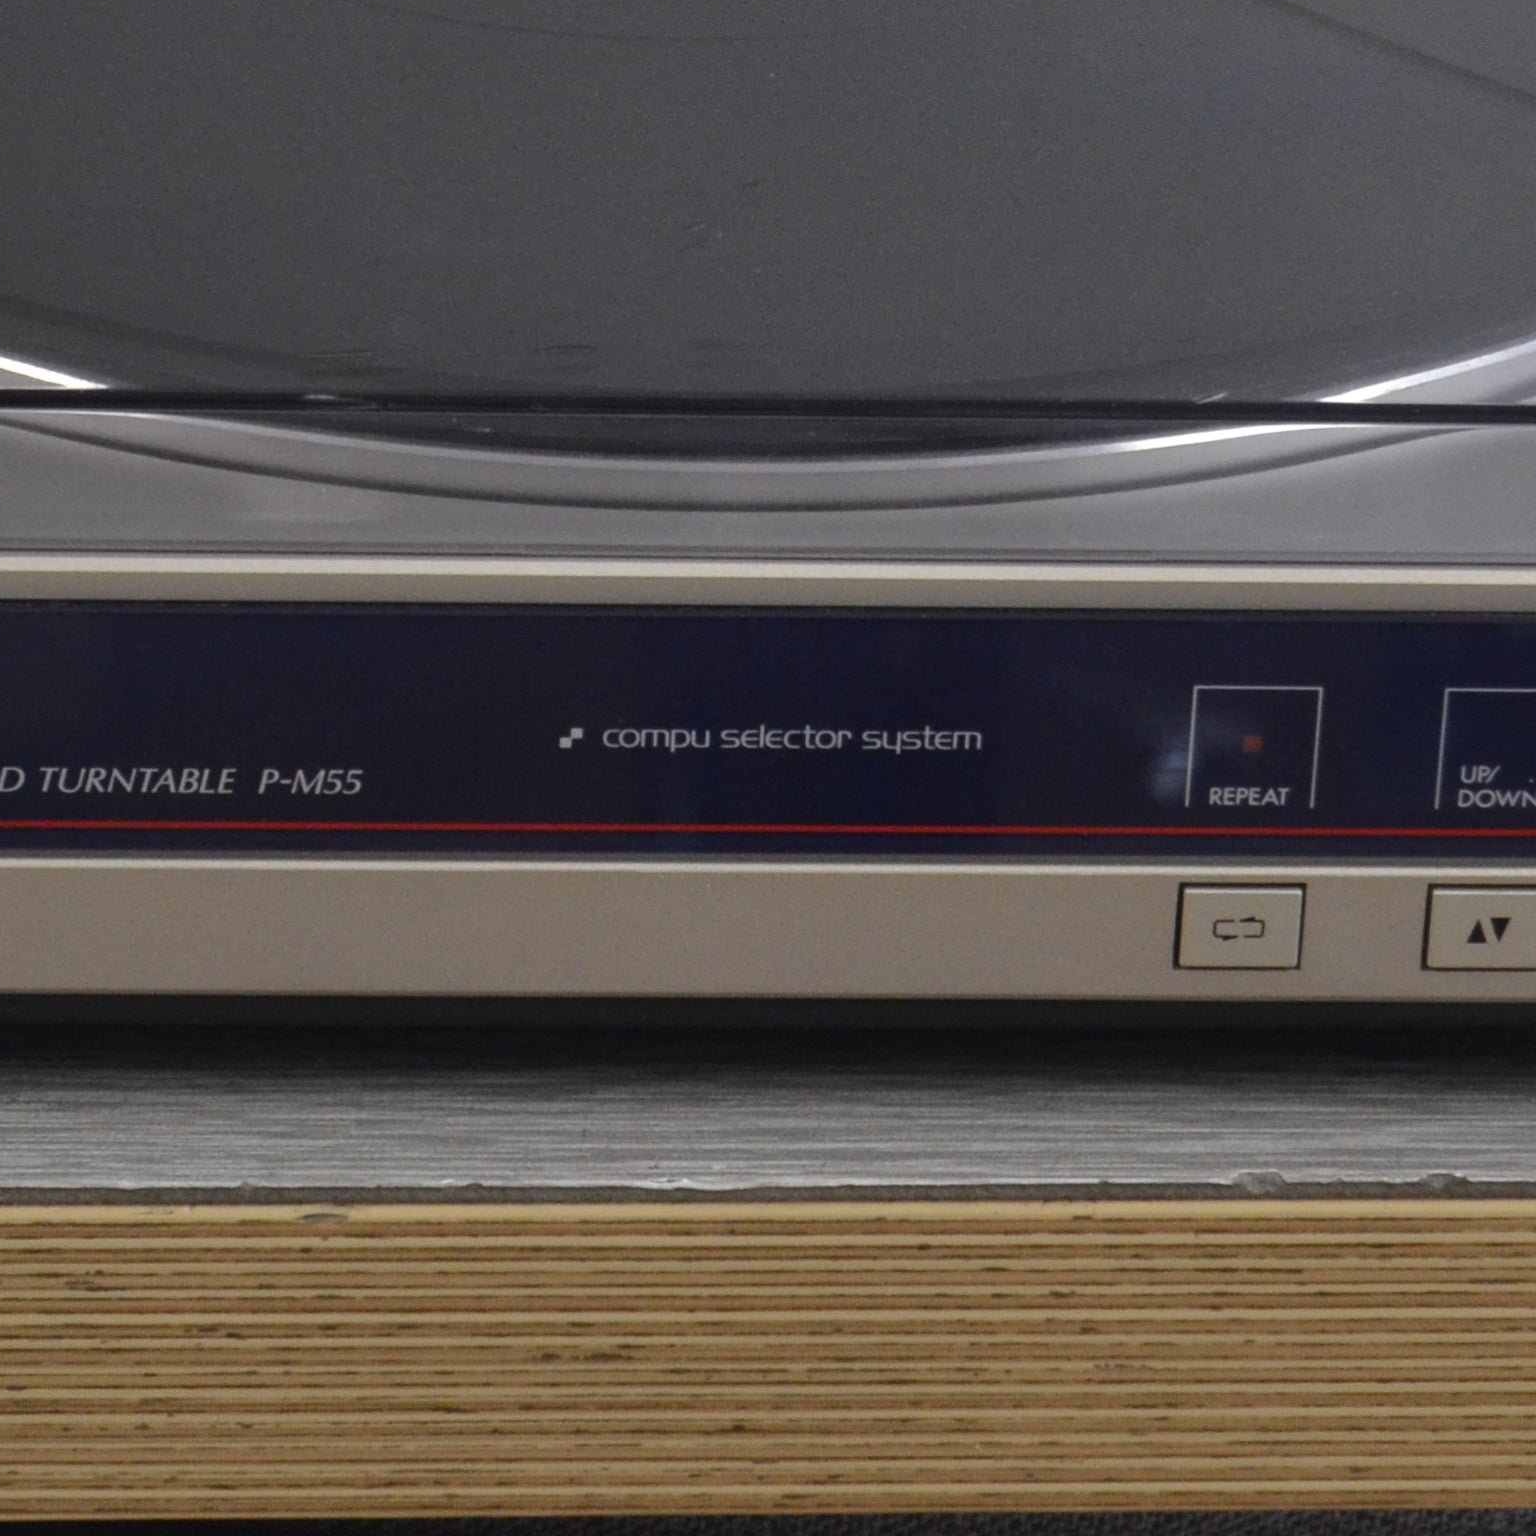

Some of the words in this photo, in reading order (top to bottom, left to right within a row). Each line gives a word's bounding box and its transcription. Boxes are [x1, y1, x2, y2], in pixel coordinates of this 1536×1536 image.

[602, 727, 710, 753] compu
[720, 725, 853, 750] selector
[862, 725, 982, 754] system
[39, 767, 237, 795] TURNTABLE
[257, 768, 363, 796] P-M55
[1460, 765, 1501, 784] UP/
[1208, 787, 1291, 807] REPEAT
